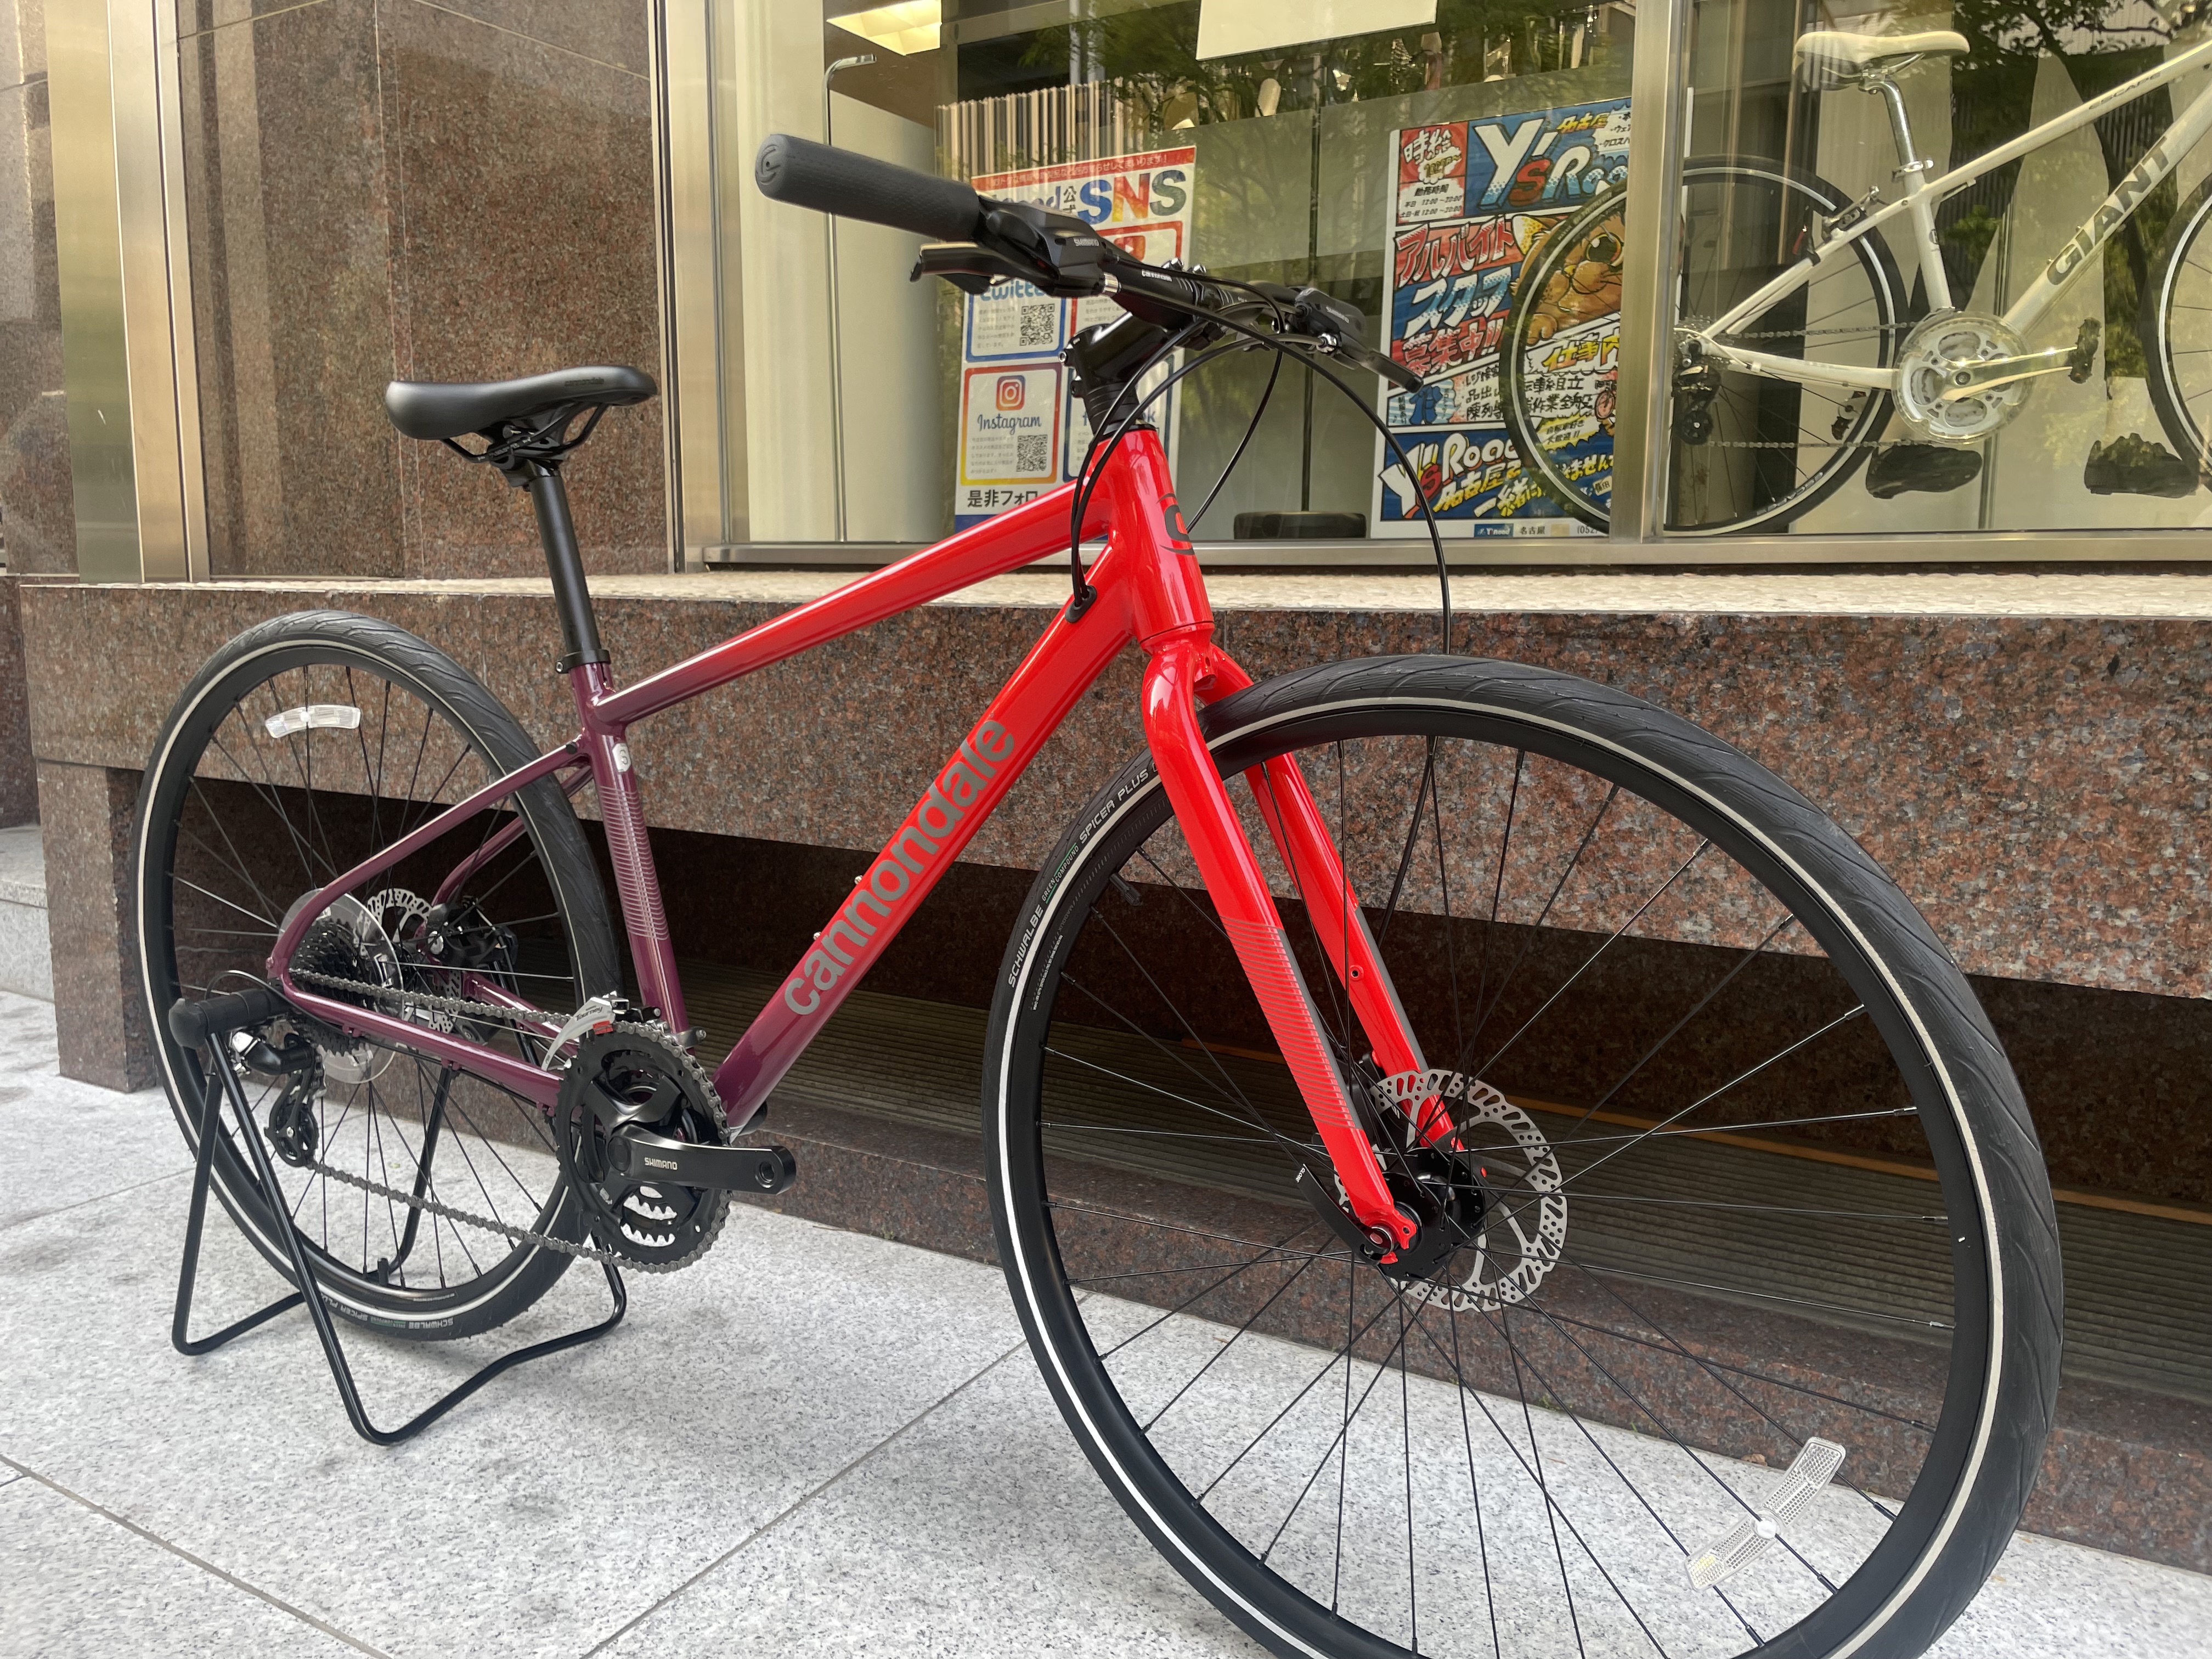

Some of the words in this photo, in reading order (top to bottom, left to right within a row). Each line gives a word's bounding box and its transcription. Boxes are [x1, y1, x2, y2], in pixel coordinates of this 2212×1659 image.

[1403, 128, 1453, 165] 時給
[1077, 169, 1187, 225] SNS
[2047, 136, 2169, 285] GIANT
[1396, 217, 1515, 288] アルバイト
[1404, 267, 1512, 340] スタッフ
[977, 413, 1042, 436] Instagram
[1520, 526, 1545, 535] 名古屋
[784, 719, 1015, 1015] cannondale
[1008, 904, 1044, 988] SCHWALBE
[1042, 877, 1056, 902] GREEN
[1054, 845, 1079, 883] COMPOUND
[1079, 799, 1116, 844] SPICER
[1117, 769, 1149, 802] PLUS
[575, 1006, 603, 1021] Tourney
[644, 1157, 678, 1171] SHIMANO
[340, 1305, 368, 1322] SPICER
[409, 1317, 454, 1329] SCHWALBE
